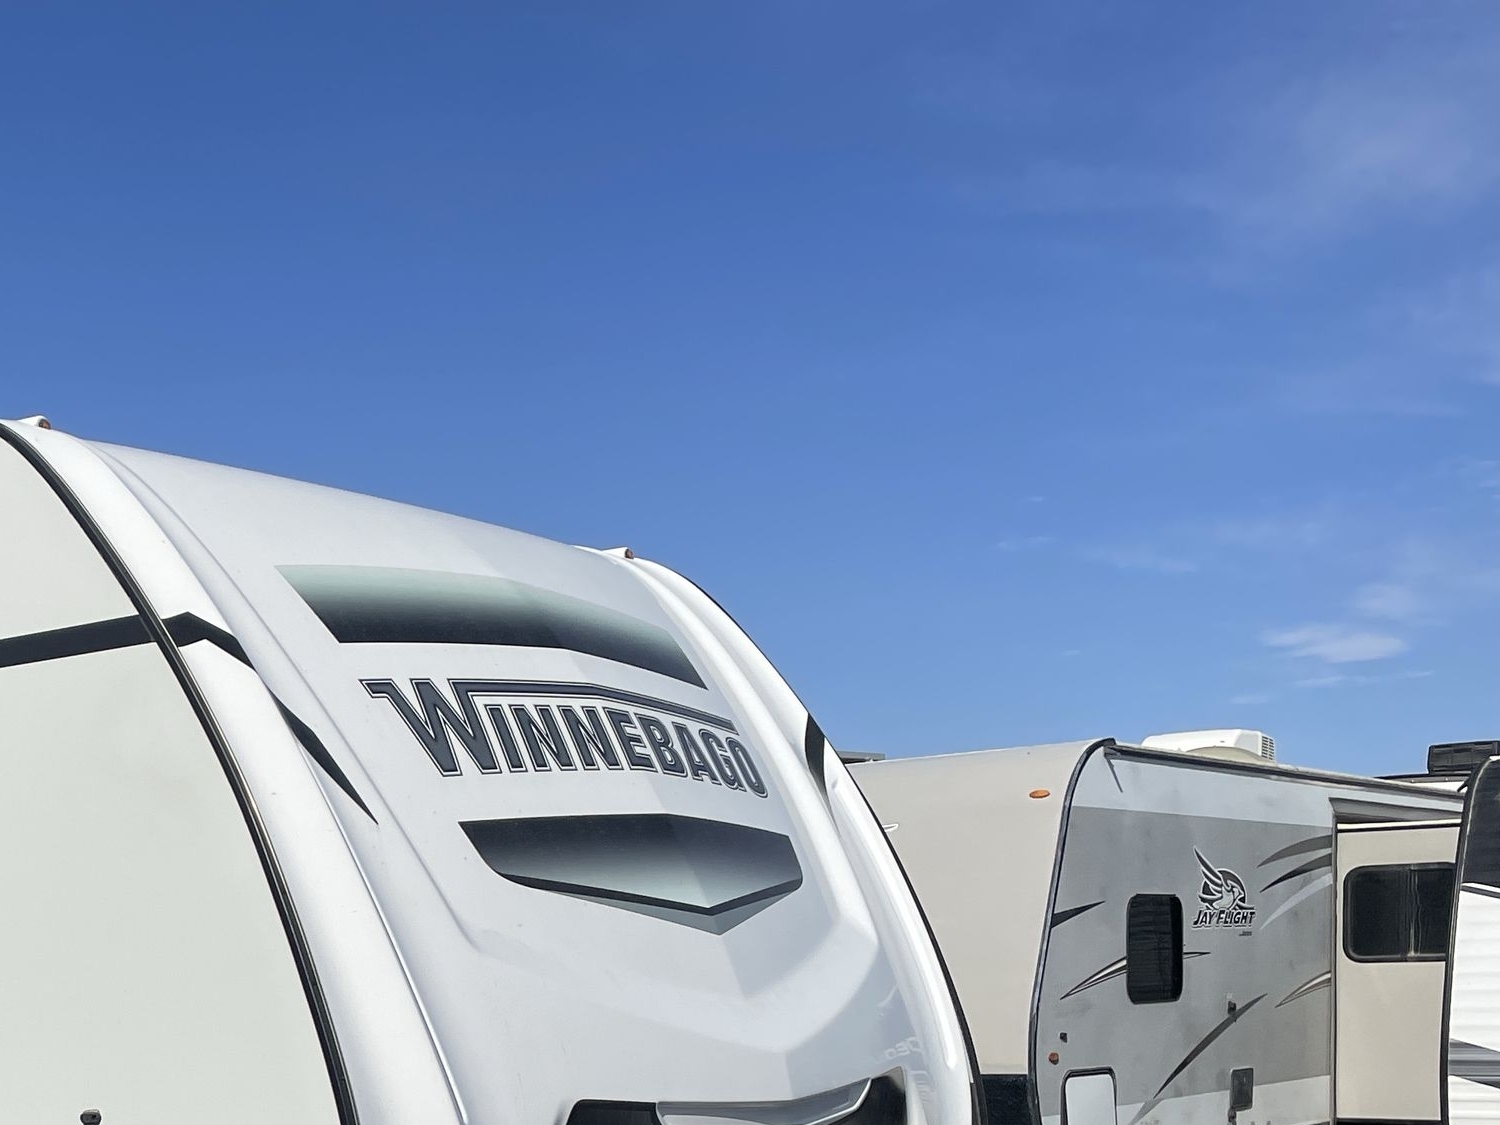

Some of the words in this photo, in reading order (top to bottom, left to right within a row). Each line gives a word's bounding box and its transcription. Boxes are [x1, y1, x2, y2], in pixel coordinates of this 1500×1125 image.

[358, 677, 768, 799] WINNEBAGO
[1192, 909, 1216, 928] JAY
[1216, 909, 1256, 928] FLIGHT
